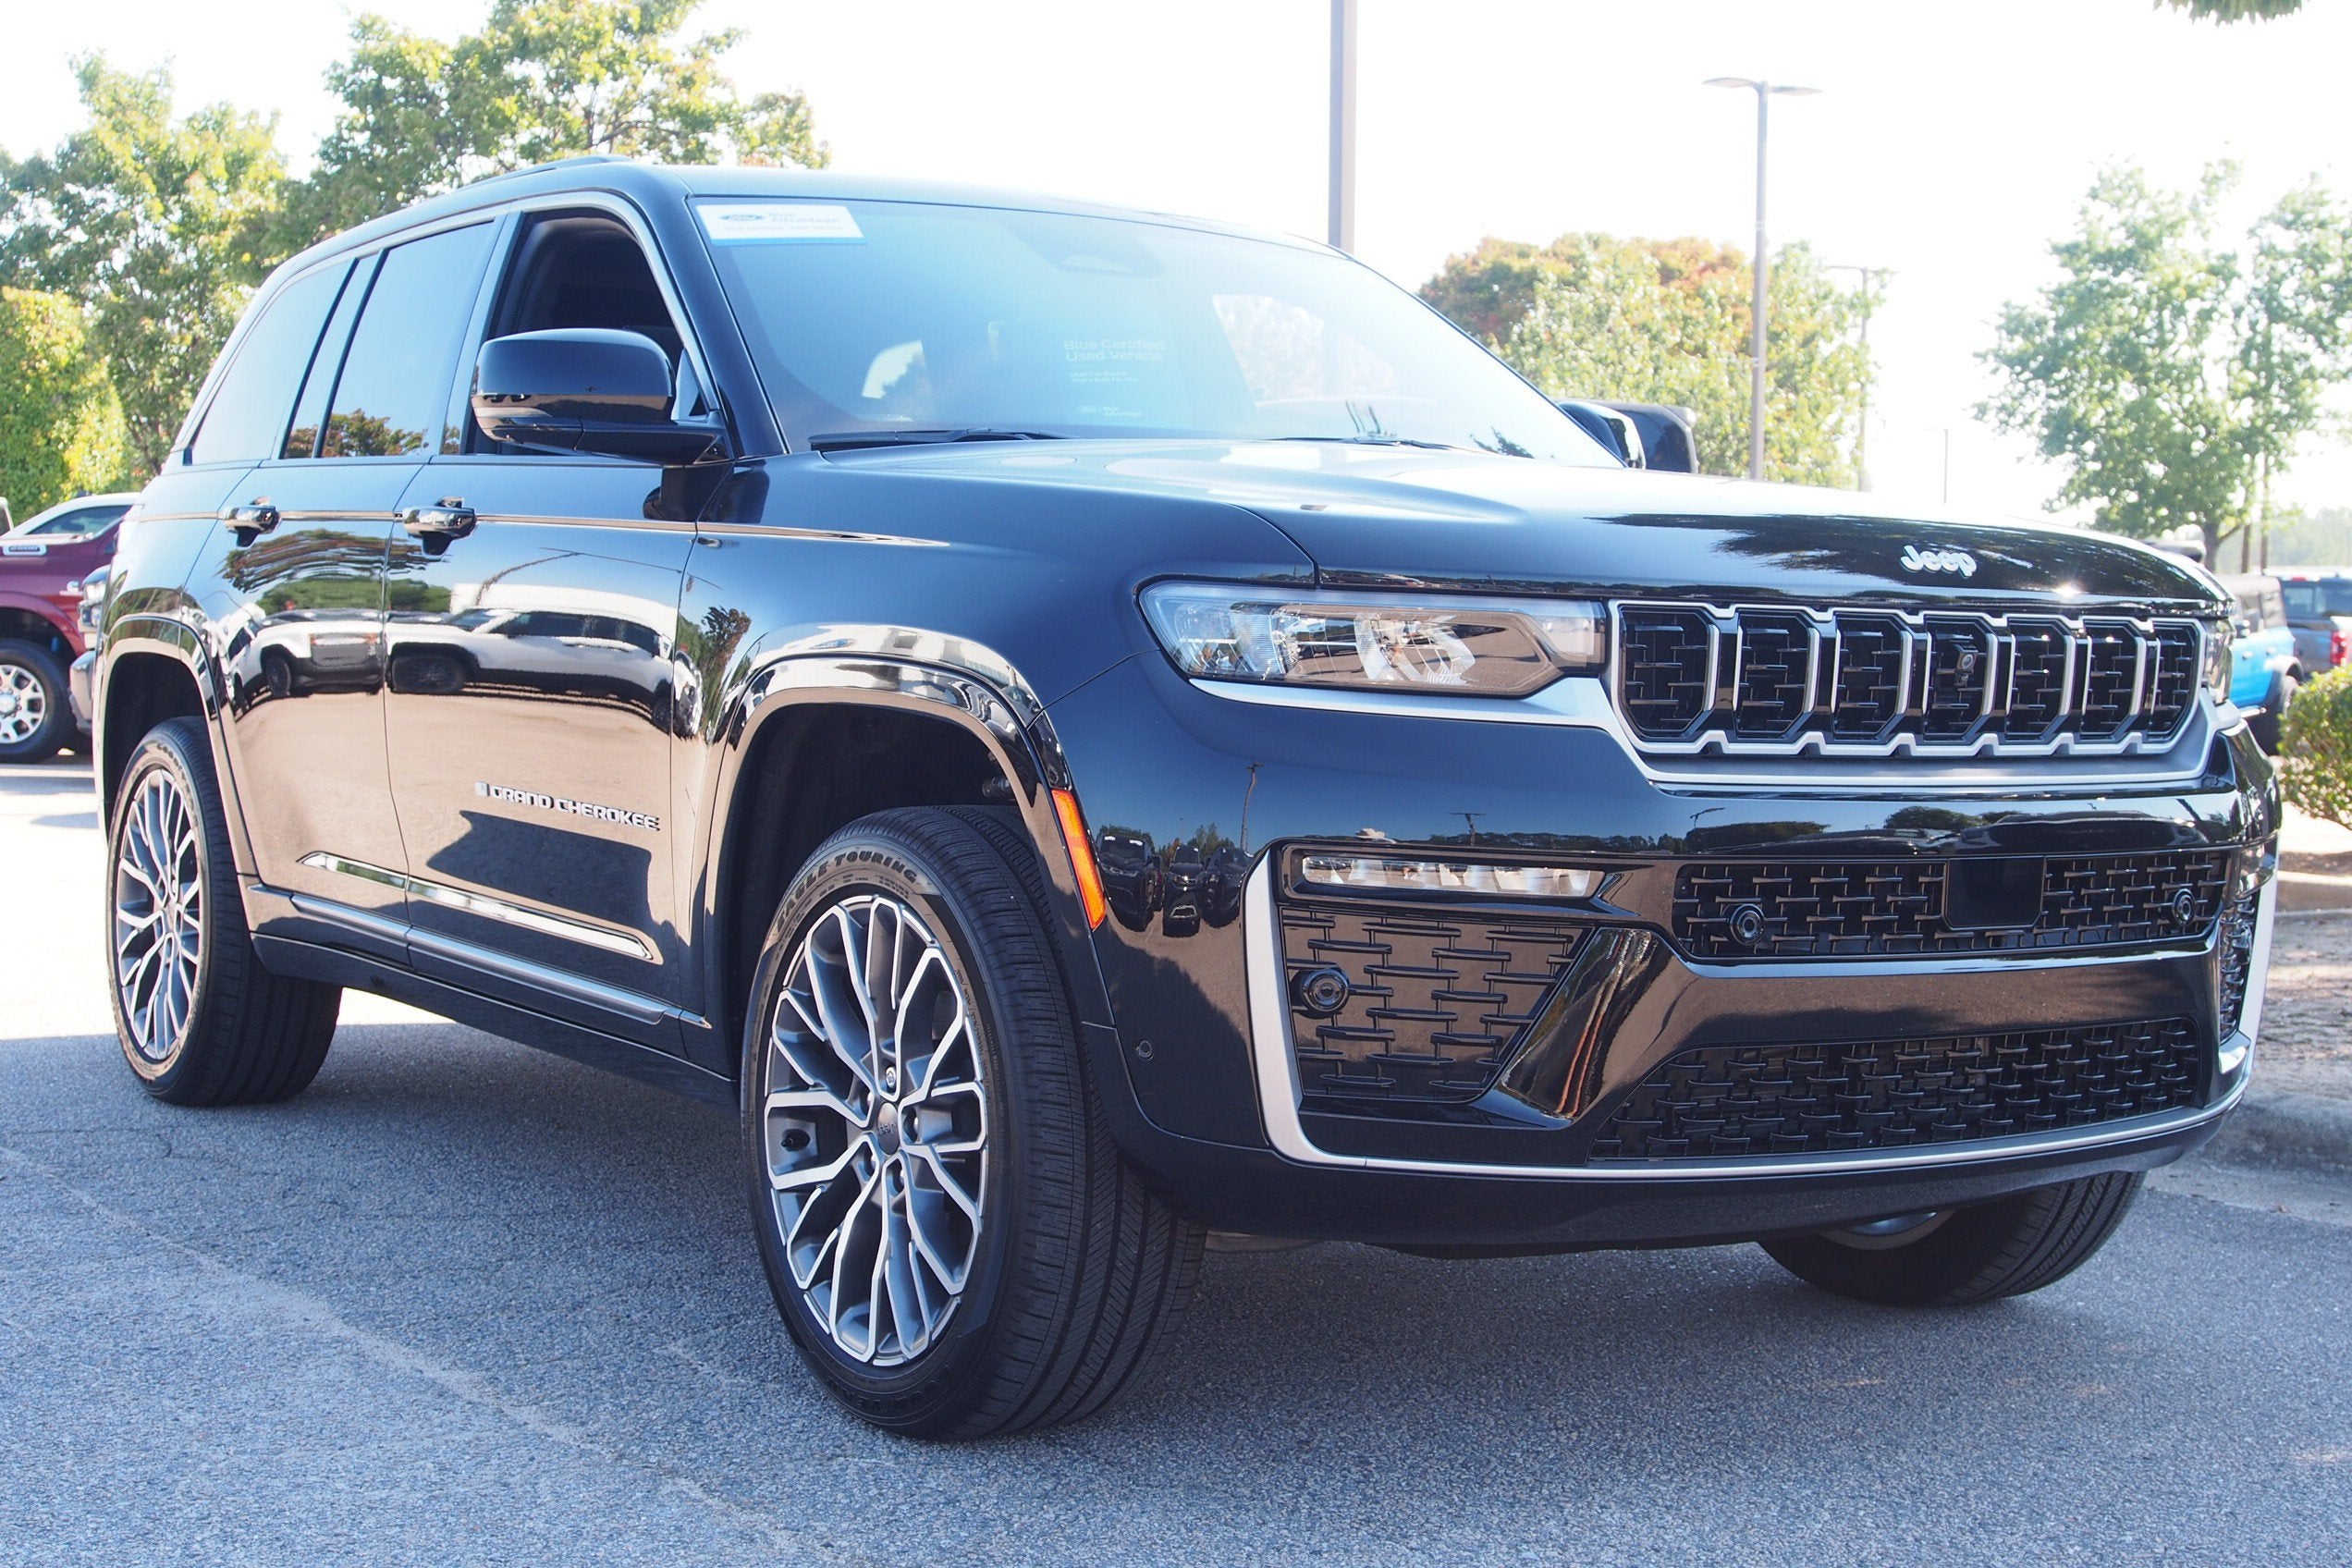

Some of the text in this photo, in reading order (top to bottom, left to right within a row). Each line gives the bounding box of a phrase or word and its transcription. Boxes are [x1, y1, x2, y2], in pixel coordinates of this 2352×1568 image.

[1063, 337, 1166, 350] Blue Certified
[1065, 349, 1164, 361] Used Vehicle
[1900, 545, 1978, 578] Jeep
[490, 785, 660, 831] GRAND CHEROKEE
[834, 850, 918, 885] TOURING
